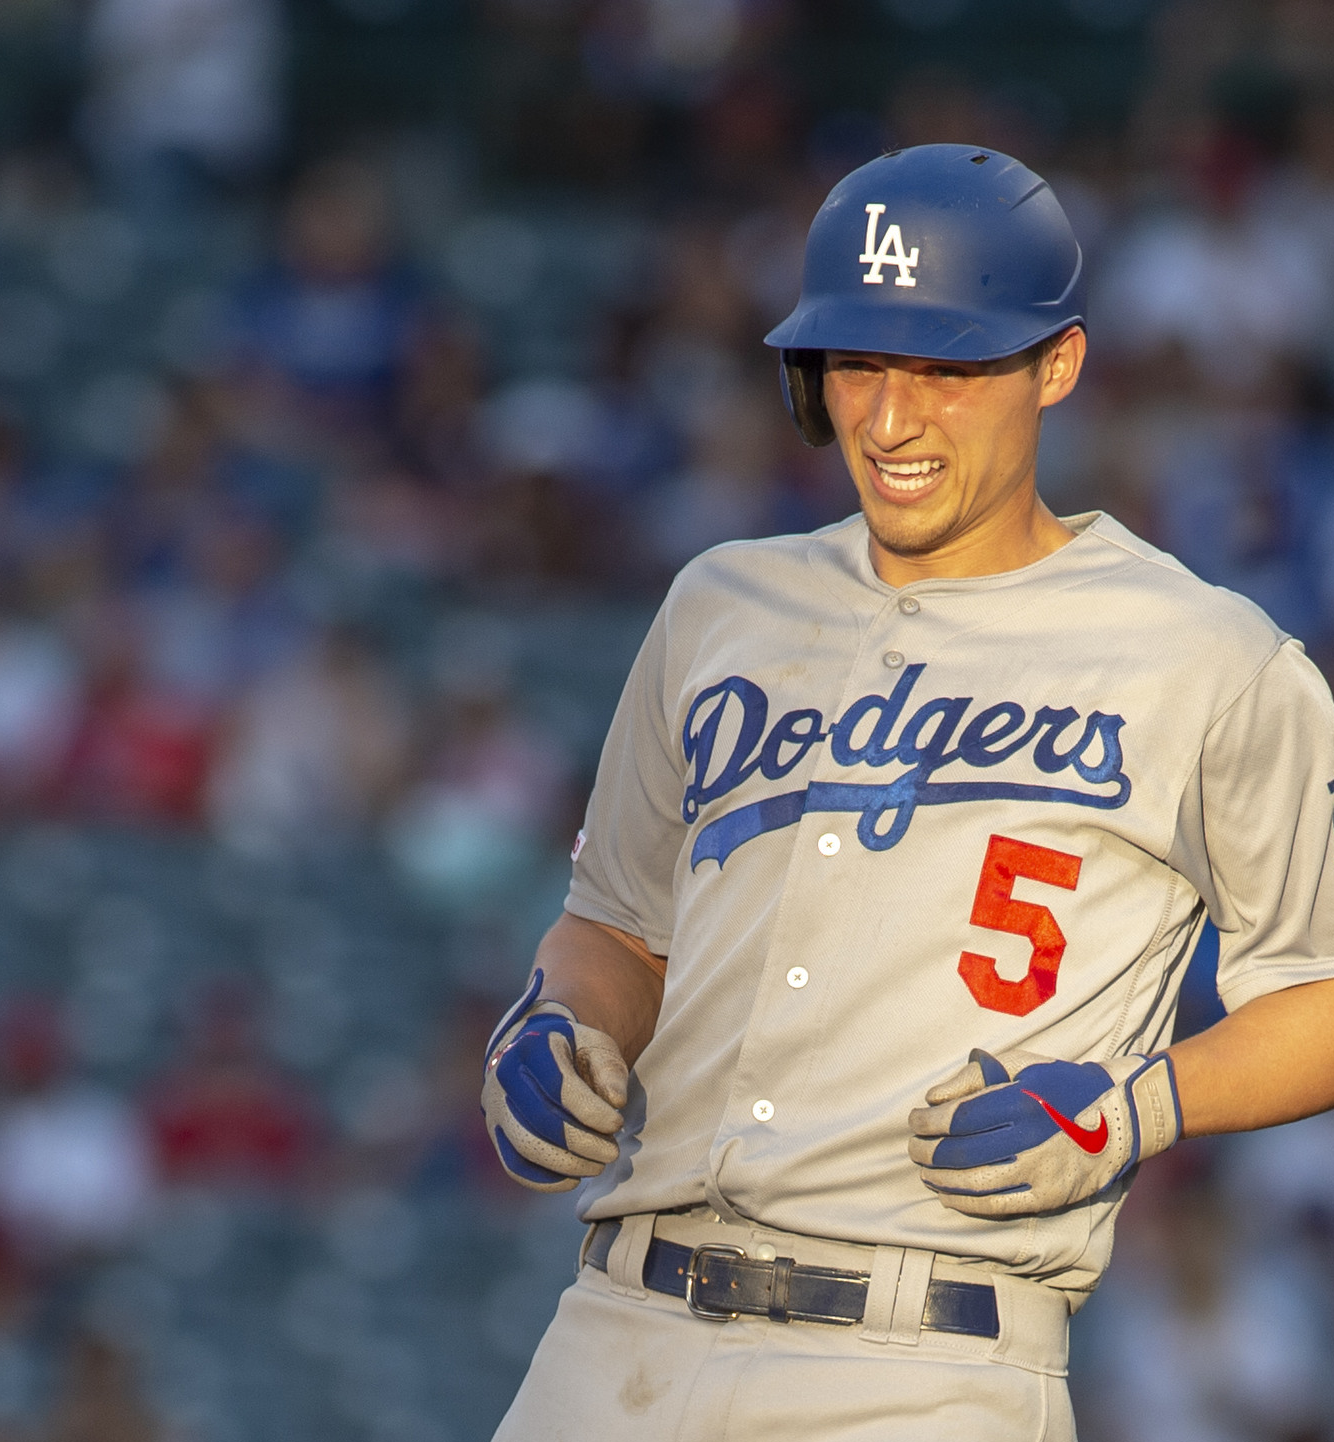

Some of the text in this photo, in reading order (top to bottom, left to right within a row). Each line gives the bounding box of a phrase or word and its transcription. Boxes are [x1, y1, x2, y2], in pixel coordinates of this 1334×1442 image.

[859, 203, 919, 287] LA
[681, 662, 1131, 872] Dodgers
[957, 834, 1082, 1018] 5
